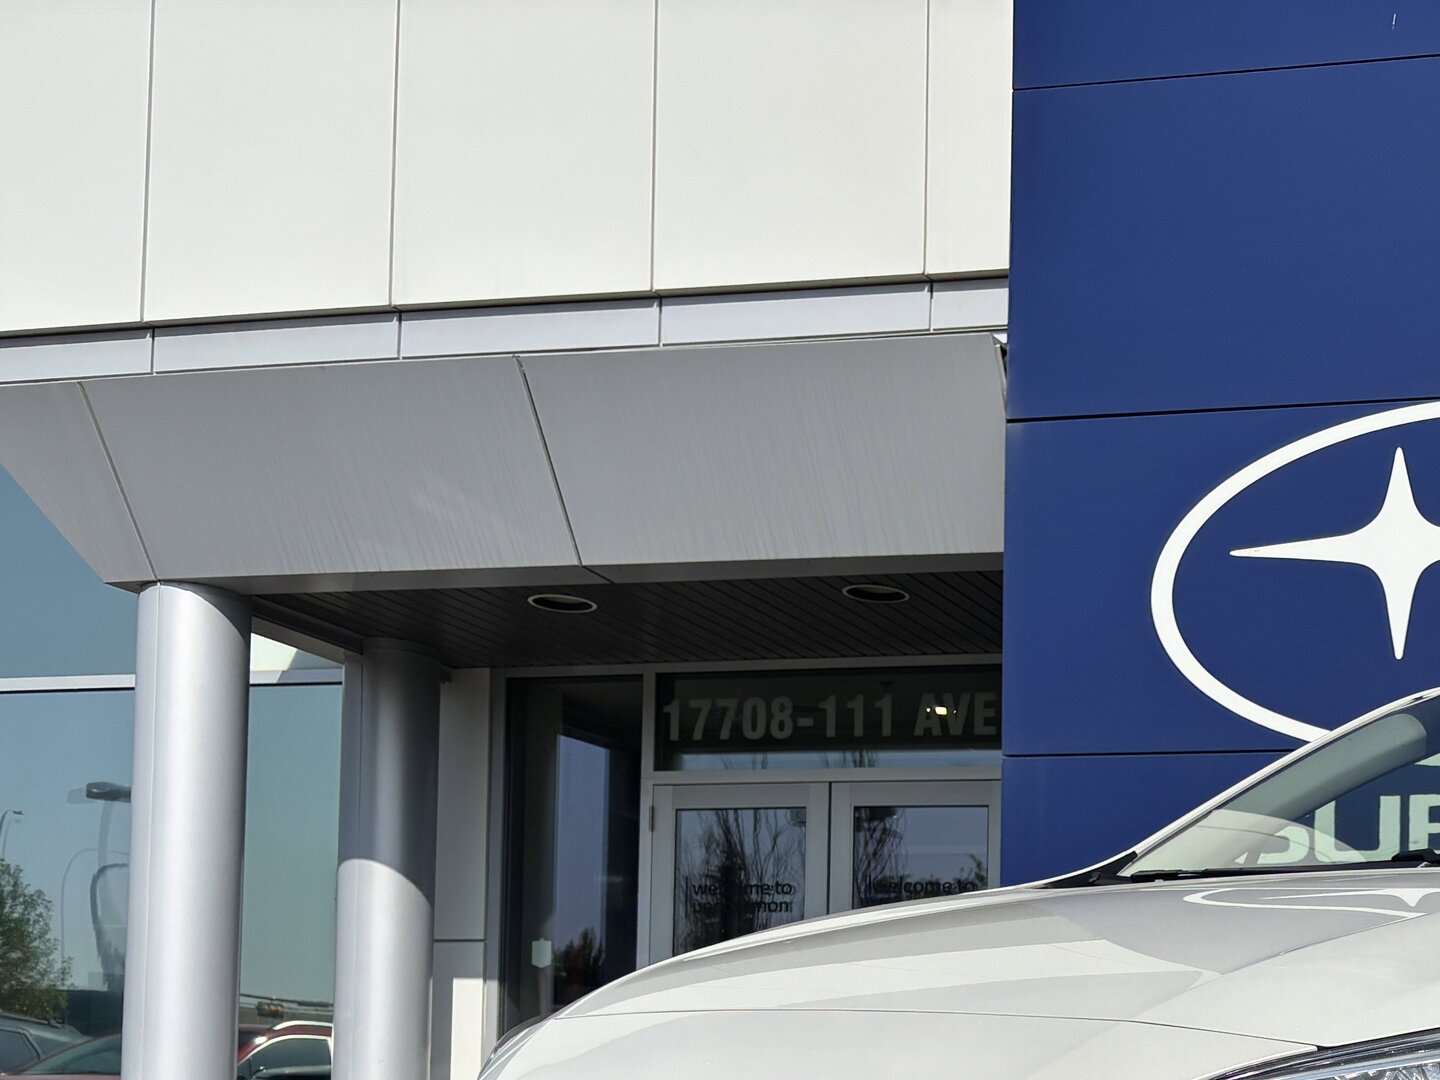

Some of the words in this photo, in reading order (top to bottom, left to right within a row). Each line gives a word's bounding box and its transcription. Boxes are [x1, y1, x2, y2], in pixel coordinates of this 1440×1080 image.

[663, 694, 892, 741] 17708-111
[914, 693, 996, 736] AVE
[775, 880, 793, 896] to
